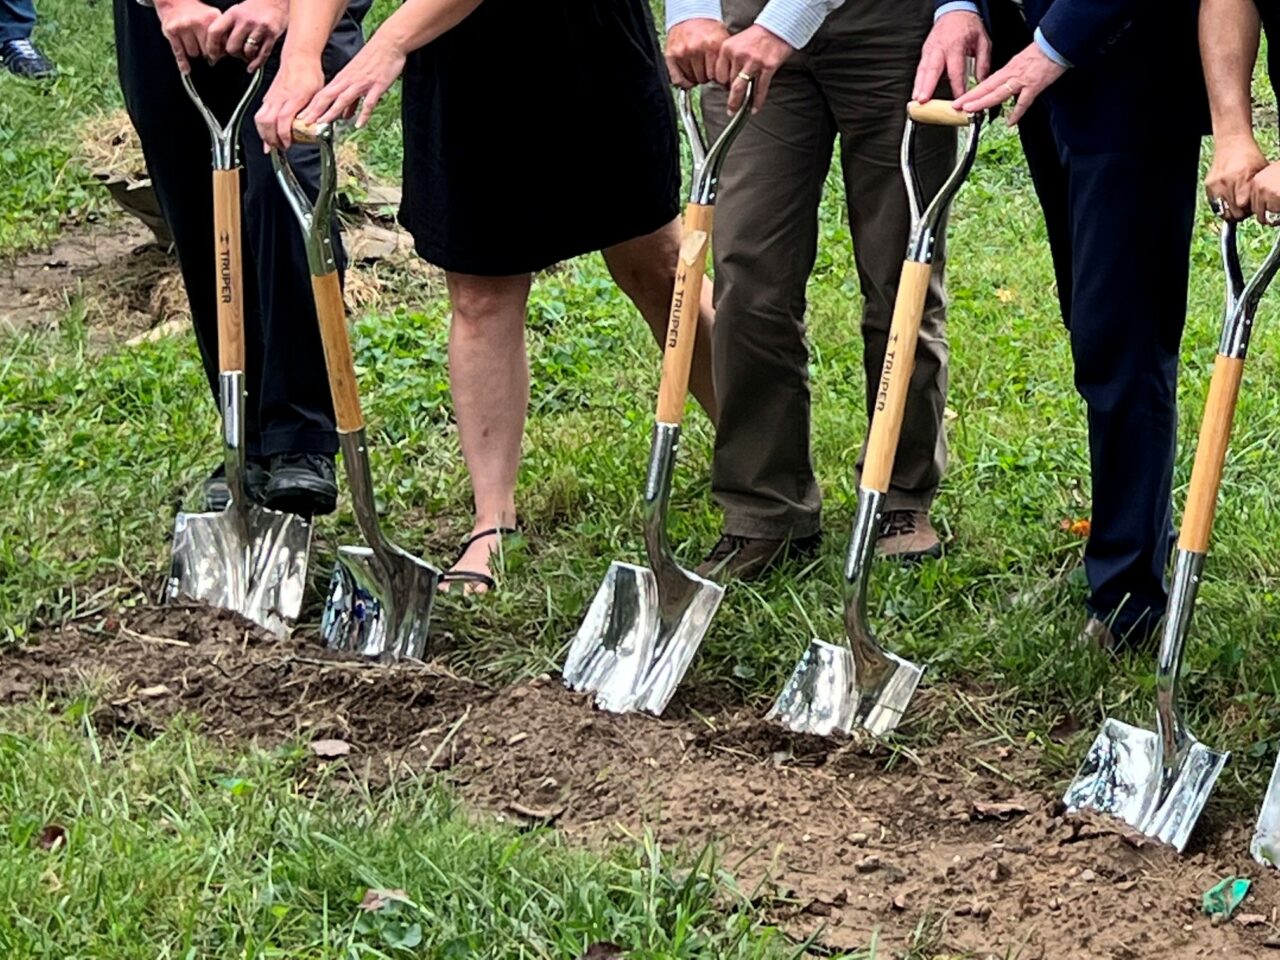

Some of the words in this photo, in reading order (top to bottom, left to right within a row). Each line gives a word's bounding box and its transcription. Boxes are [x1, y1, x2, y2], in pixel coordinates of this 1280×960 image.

[220, 249, 232, 304] TRUPER
[668, 290, 684, 348] TRUPER
[877, 351, 895, 412] TRUPER
